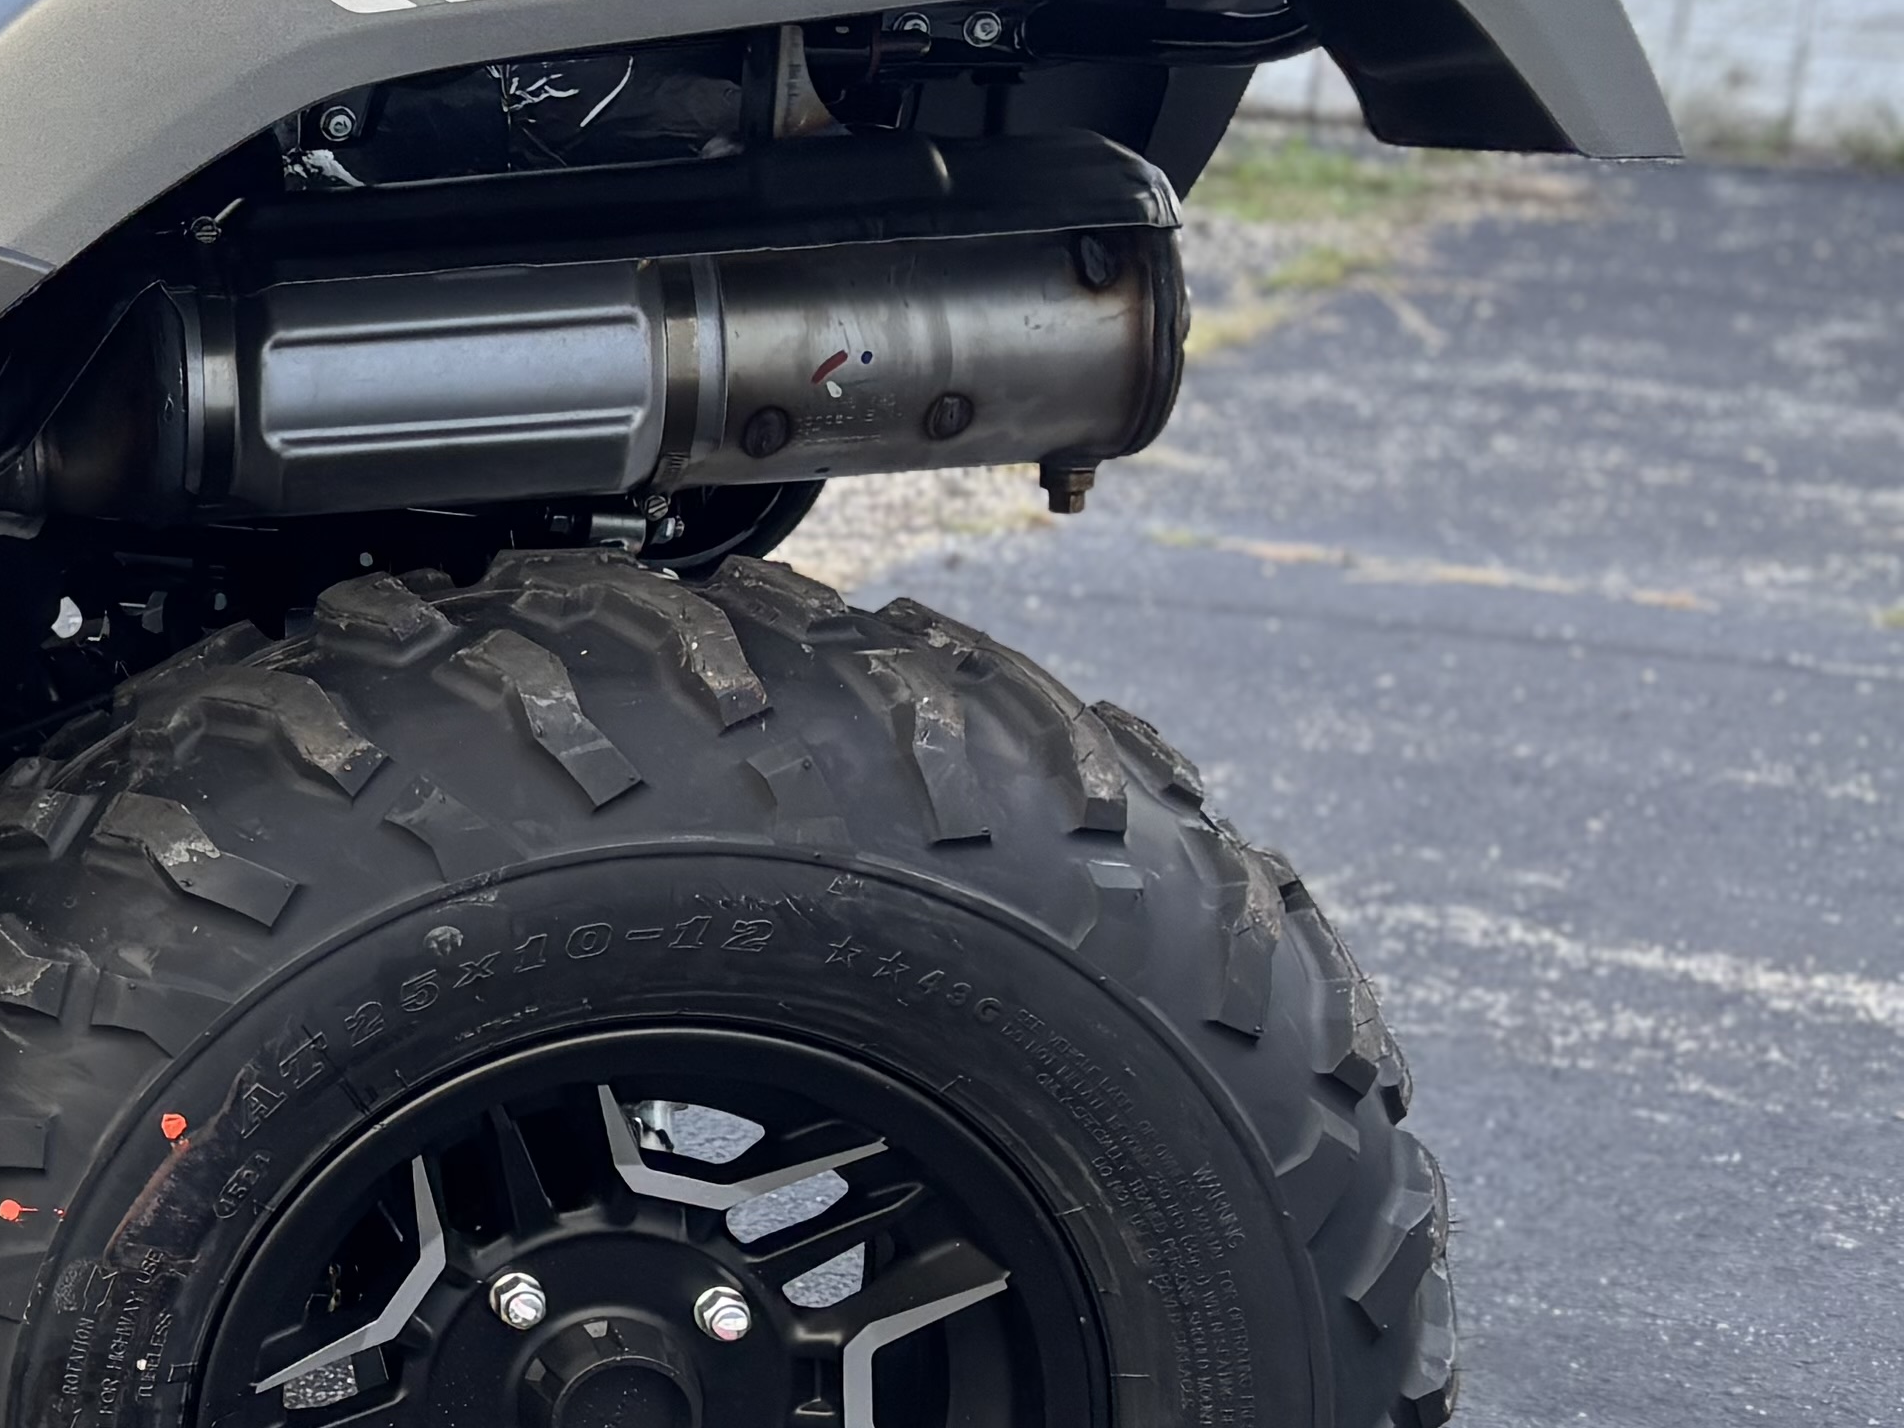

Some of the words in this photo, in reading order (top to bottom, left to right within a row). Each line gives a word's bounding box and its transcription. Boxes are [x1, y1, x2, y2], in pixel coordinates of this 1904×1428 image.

[62, 1317, 94, 1395] ROTATION
[106, 1291, 145, 1370] HIGHWAY
[136, 1248, 164, 1284] USE
